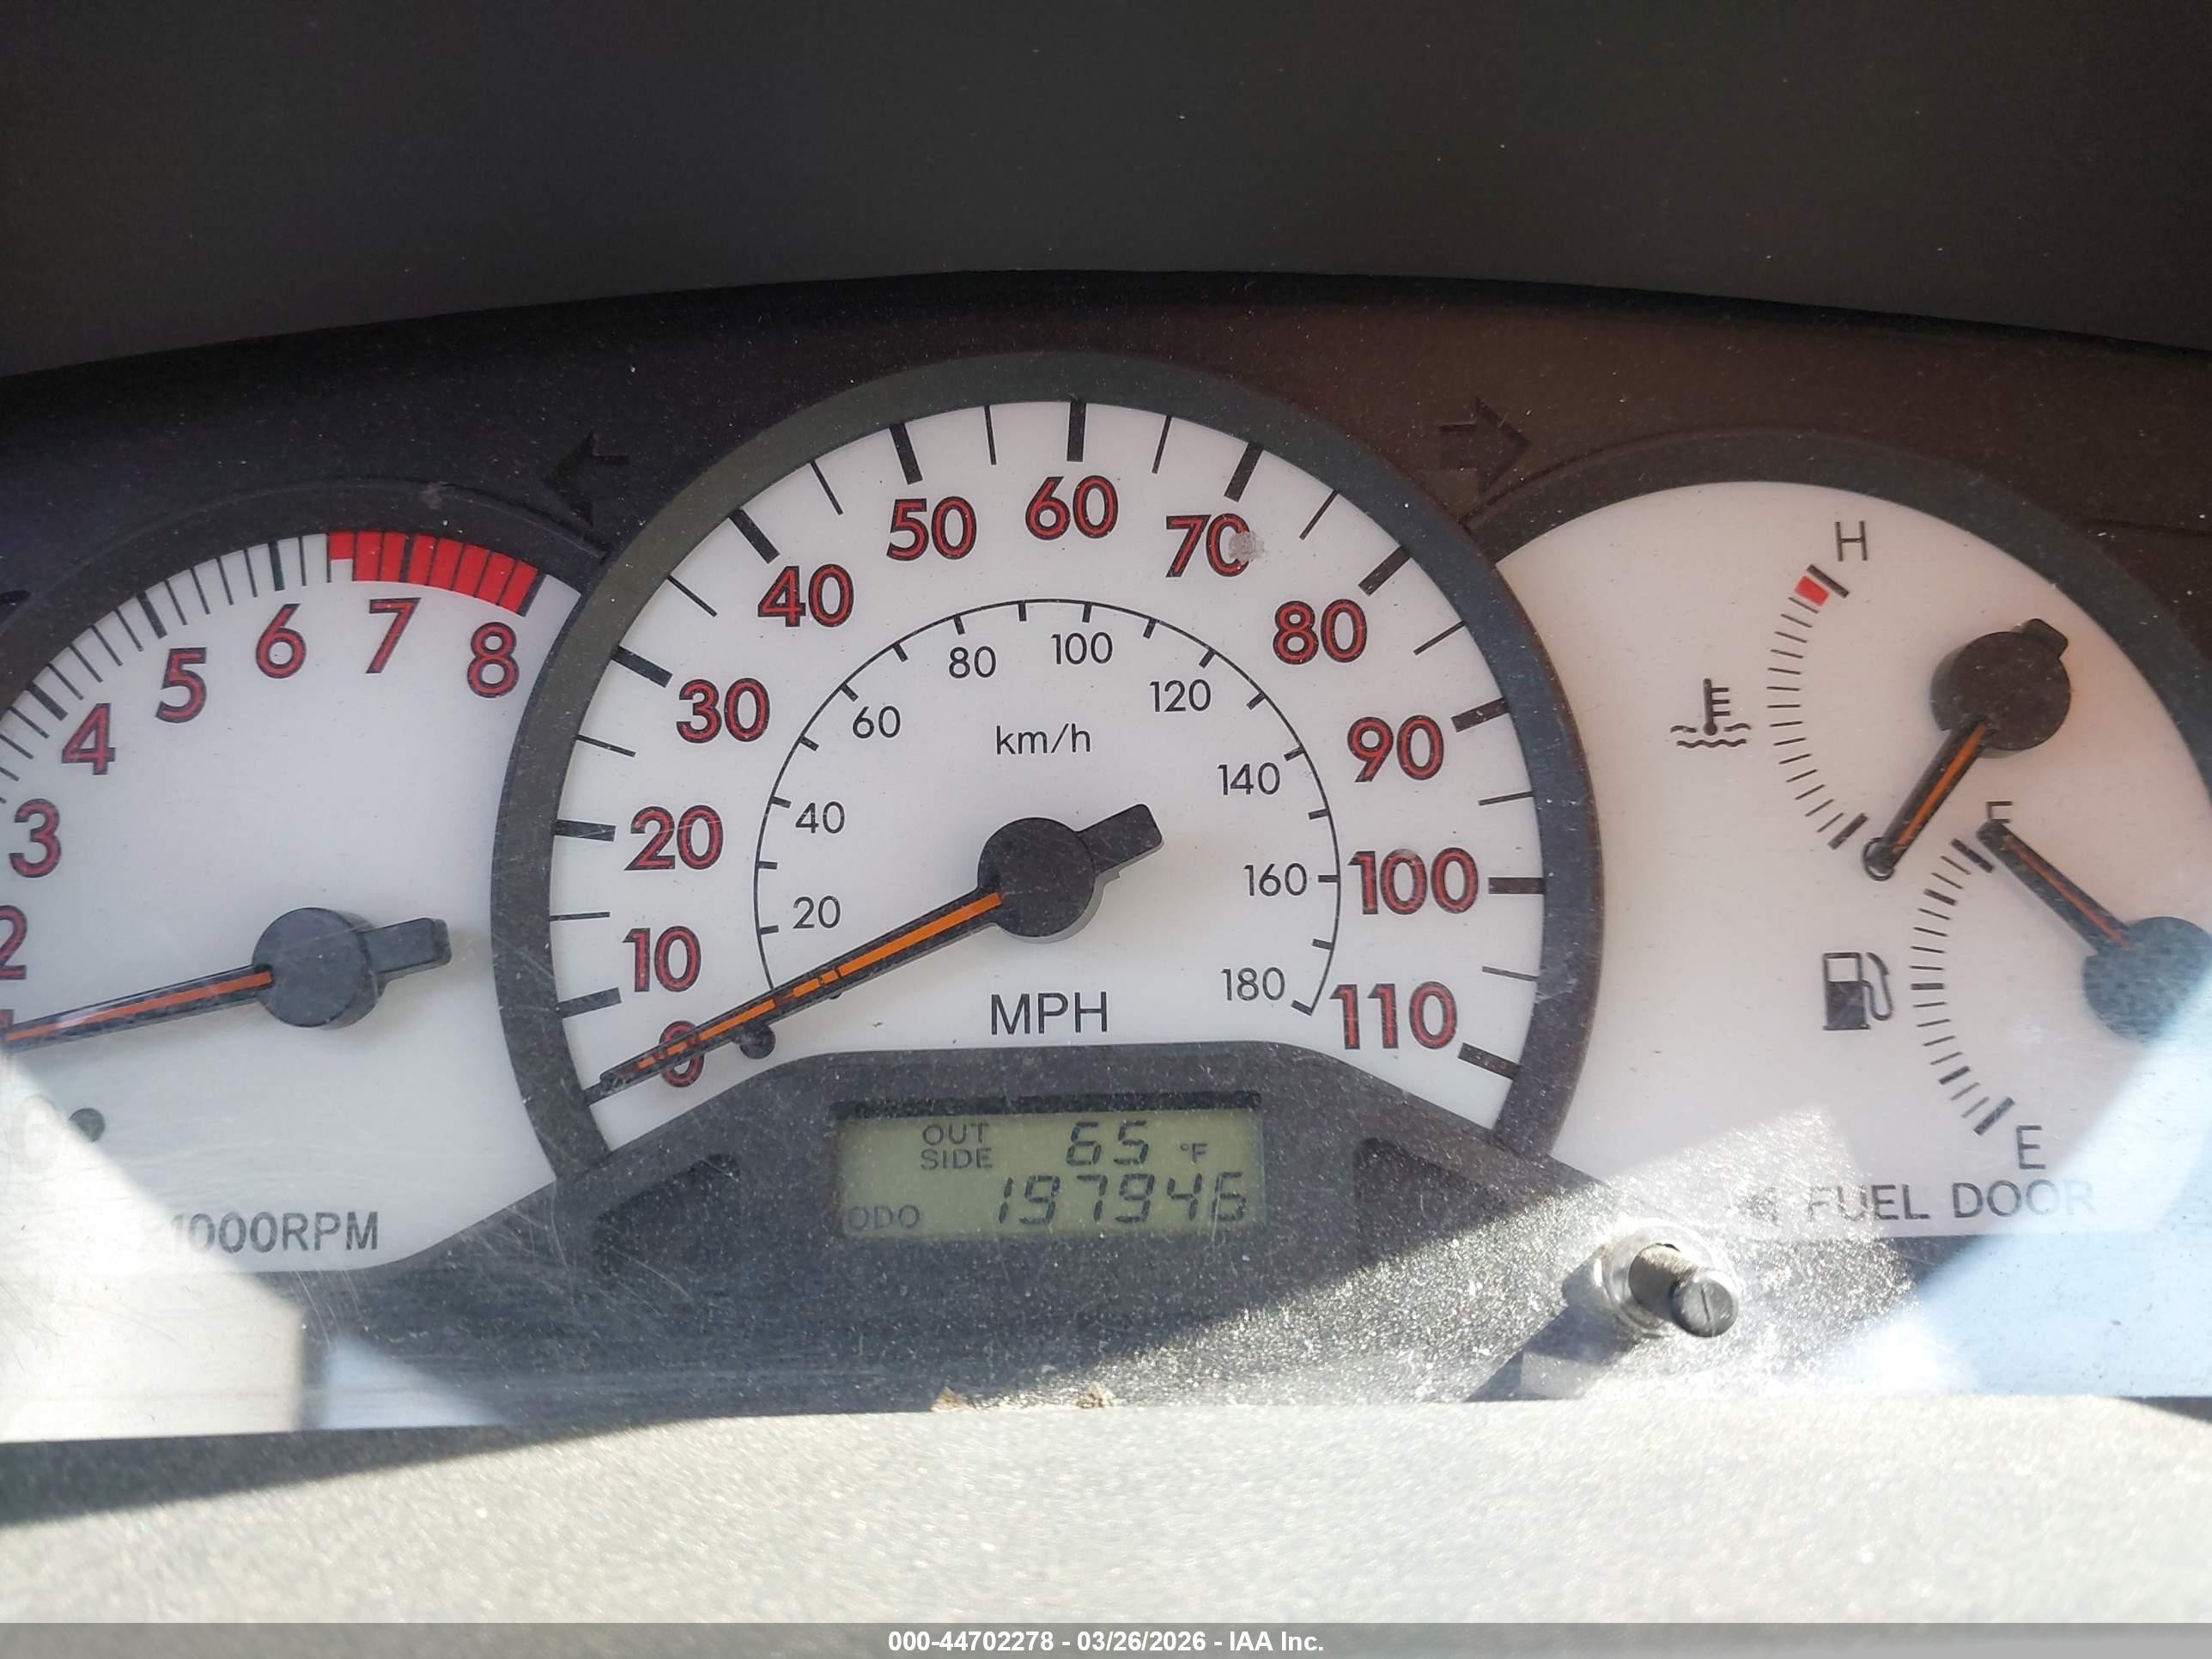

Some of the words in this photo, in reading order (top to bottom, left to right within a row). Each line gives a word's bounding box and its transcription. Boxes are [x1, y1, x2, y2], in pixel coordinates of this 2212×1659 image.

[885, 495, 978, 562] 50
[1024, 474, 1120, 541] 60
[1164, 512, 1252, 579] 70
[1834, 520, 1869, 562] H
[756, 563, 855, 629] 40
[254, 603, 307, 680] 6
[365, 596, 422, 675] 7
[1049, 631, 1115, 666] 100
[1271, 598, 1369, 666] 80
[155, 647, 208, 724] 5
[465, 621, 520, 699] 8
[946, 645, 998, 680] 80
[674, 677, 771, 745] 30
[850, 705, 902, 739] 60
[1147, 678, 1212, 713] 120
[60, 702, 117, 776] 4
[994, 723, 1092, 757] km/h
[1346, 714, 1446, 784] 90
[1216, 761, 1282, 797] 140
[8, 798, 63, 879] 3
[623, 804, 725, 872] 20
[793, 800, 847, 835] 40
[1242, 861, 1308, 897] 160
[1346, 847, 1480, 916] 100
[791, 895, 842, 929] 20
[621, 925, 702, 993] 10
[1221, 966, 1286, 1002] 180
[989, 990, 1109, 1036] MPH
[1328, 981, 1458, 1051] 110
[658, 1019, 706, 1088] 0
[920, 1147, 994, 1170] SIDE
[921, 1123, 990, 1146] OUT
[1066, 1120, 1150, 1167] 65
[2015, 1124, 2046, 1170] E
[848, 1204, 921, 1231] ODO
[998, 1171, 1248, 1225] 197946
[1807, 1183, 1930, 1222] FUEL
[1951, 1180, 2097, 1221] DOOR
